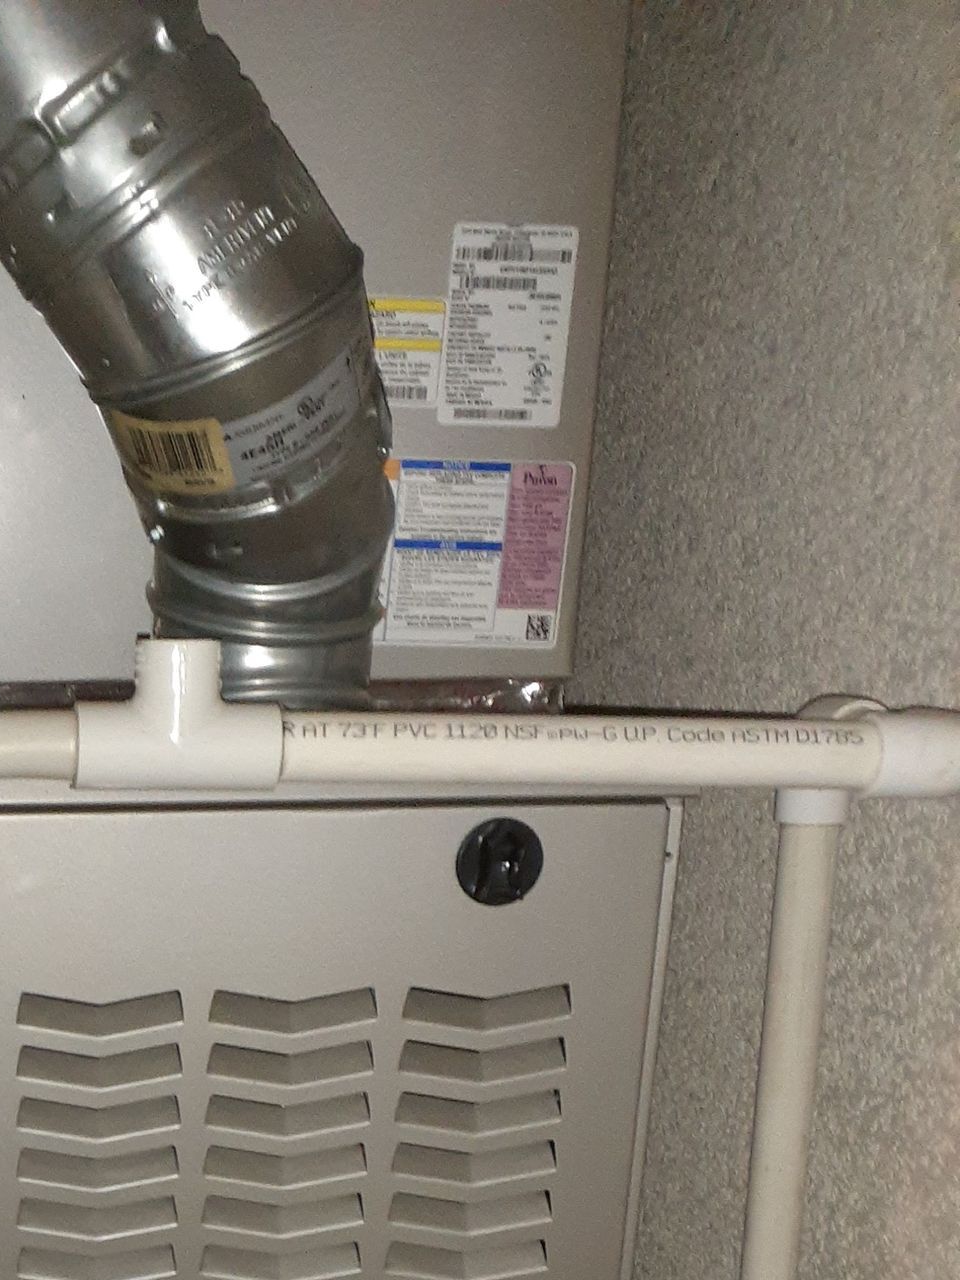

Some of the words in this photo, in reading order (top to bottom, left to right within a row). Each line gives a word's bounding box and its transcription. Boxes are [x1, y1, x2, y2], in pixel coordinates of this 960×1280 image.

[393, 721, 438, 739] PVC
[447, 722, 499, 739] 1120
[667, 727, 725, 743] Code
[732, 728, 790, 744] ASTM
